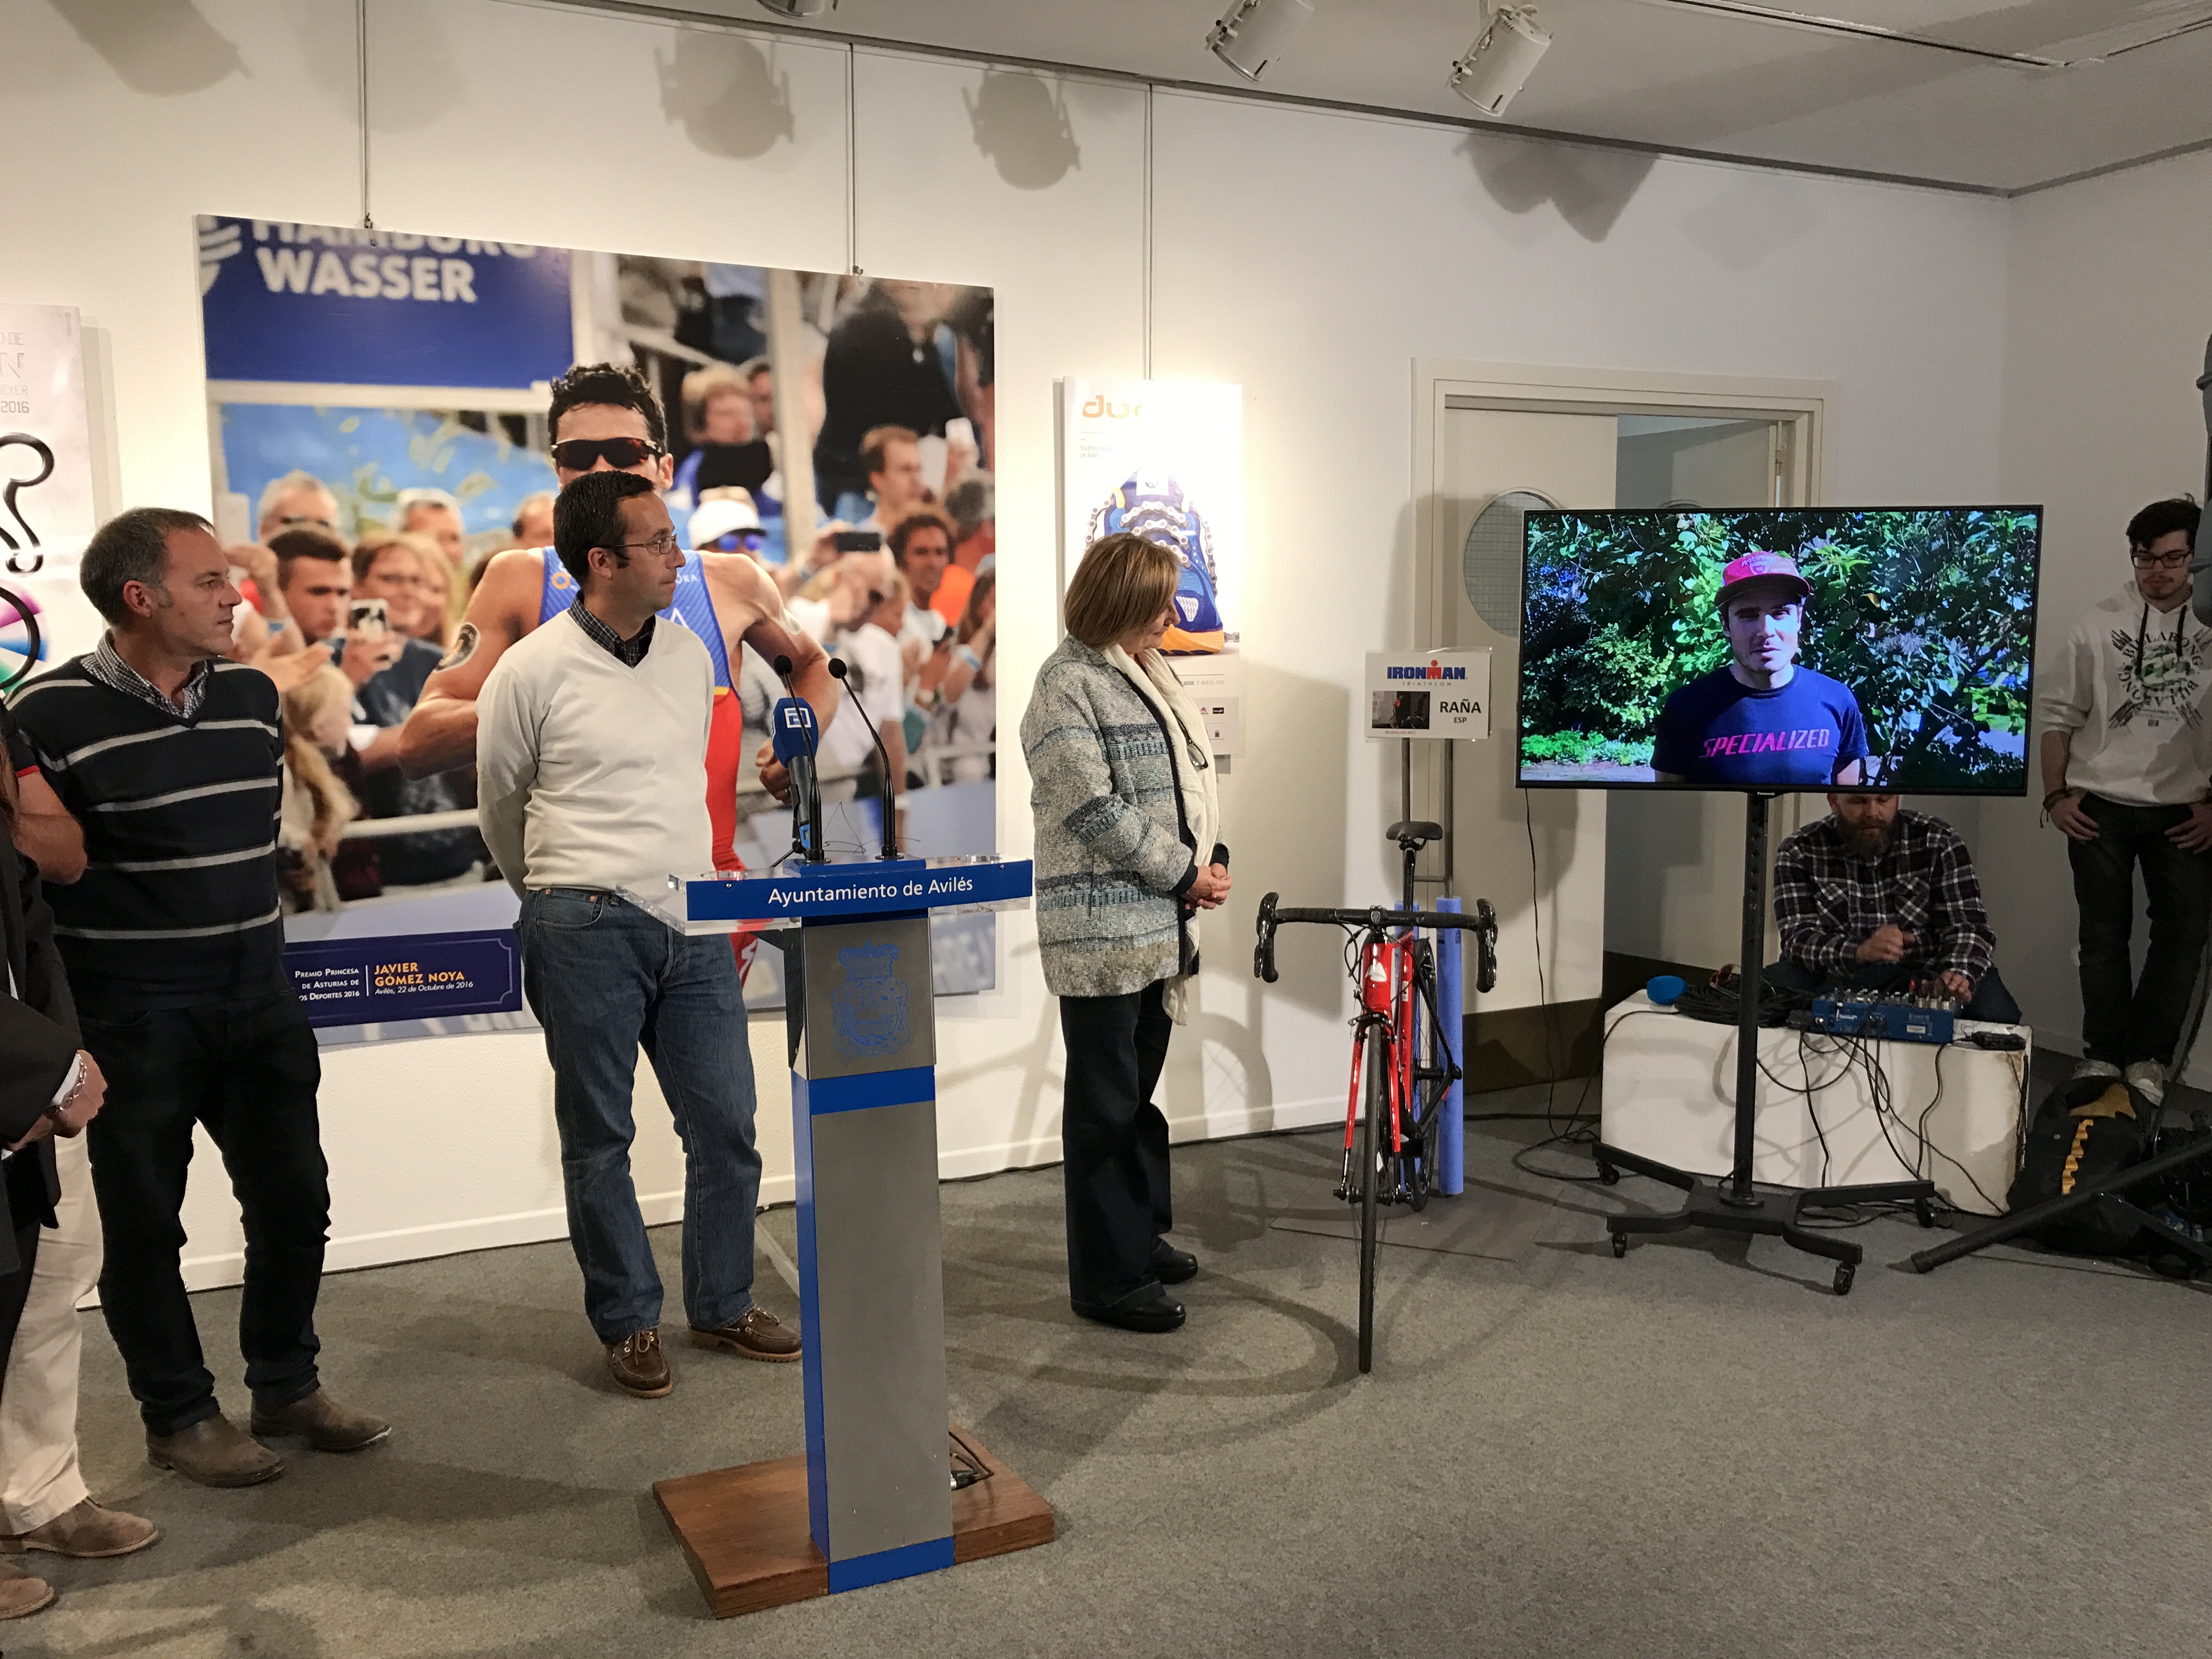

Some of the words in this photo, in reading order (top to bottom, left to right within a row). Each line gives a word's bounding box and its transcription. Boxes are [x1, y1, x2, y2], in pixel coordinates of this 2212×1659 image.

[256, 247, 477, 303] WASSER
[0, 385, 28, 395] EYER
[1, 400, 30, 413] 2016
[1387, 665, 1466, 680] IRONMAN
[1440, 698, 1482, 714] RAÑA
[1699, 729, 1830, 758] SPECIALIZED
[768, 884, 898, 907] Ayuntamiento
[902, 880, 923, 896] de
[928, 876, 973, 894] Avilés
[325, 968, 359, 976] PRINCESA
[374, 962, 419, 975] JAVIER
[313, 980, 348, 989] ASTURIAS
[374, 973, 424, 987] GÓMEZ
[428, 971, 465, 983] NOYA
[417, 983, 445, 992] Octubre
[455, 980, 473, 989] 2016
[309, 991, 342, 1001] DEPORTES
